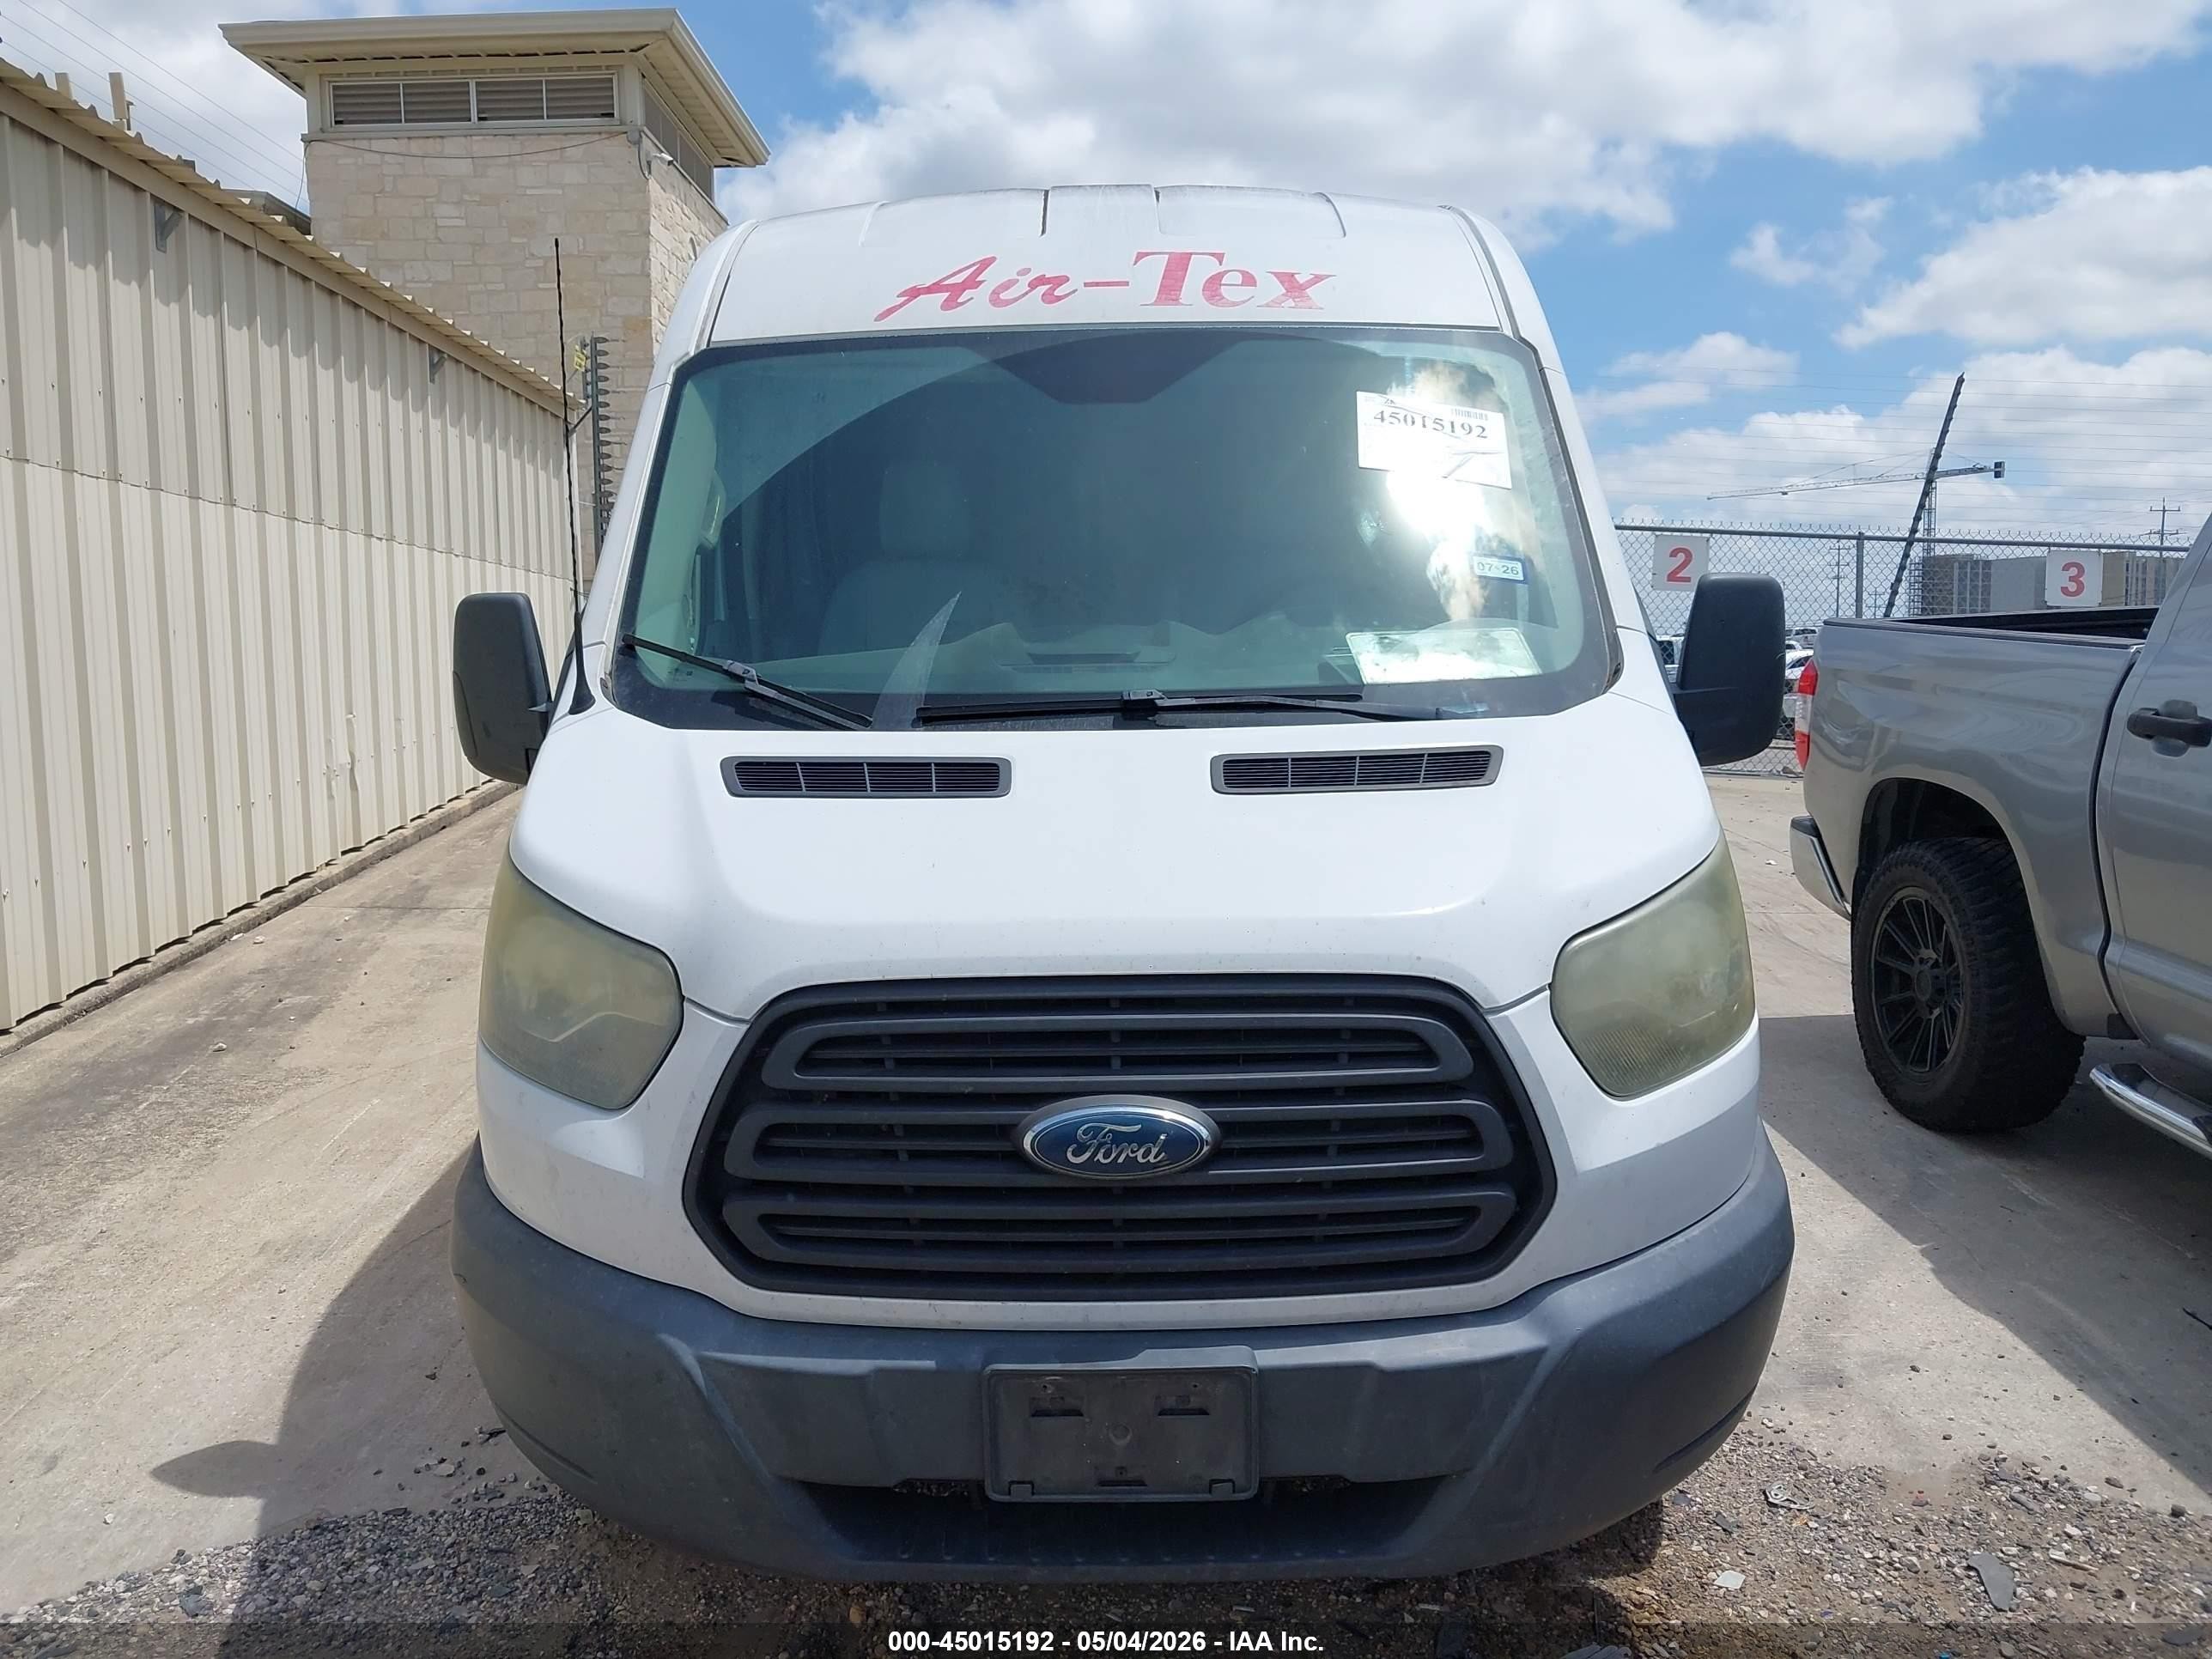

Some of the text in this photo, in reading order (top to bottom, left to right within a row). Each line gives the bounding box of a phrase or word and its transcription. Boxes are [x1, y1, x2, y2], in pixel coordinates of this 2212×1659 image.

[873, 251, 1336, 322] Air-Tex
[1373, 410, 1489, 440] 45015192
[1667, 547, 1692, 583] 2
[2060, 562, 2086, 598] 3
[1066, 1121, 1172, 1164] Ford
